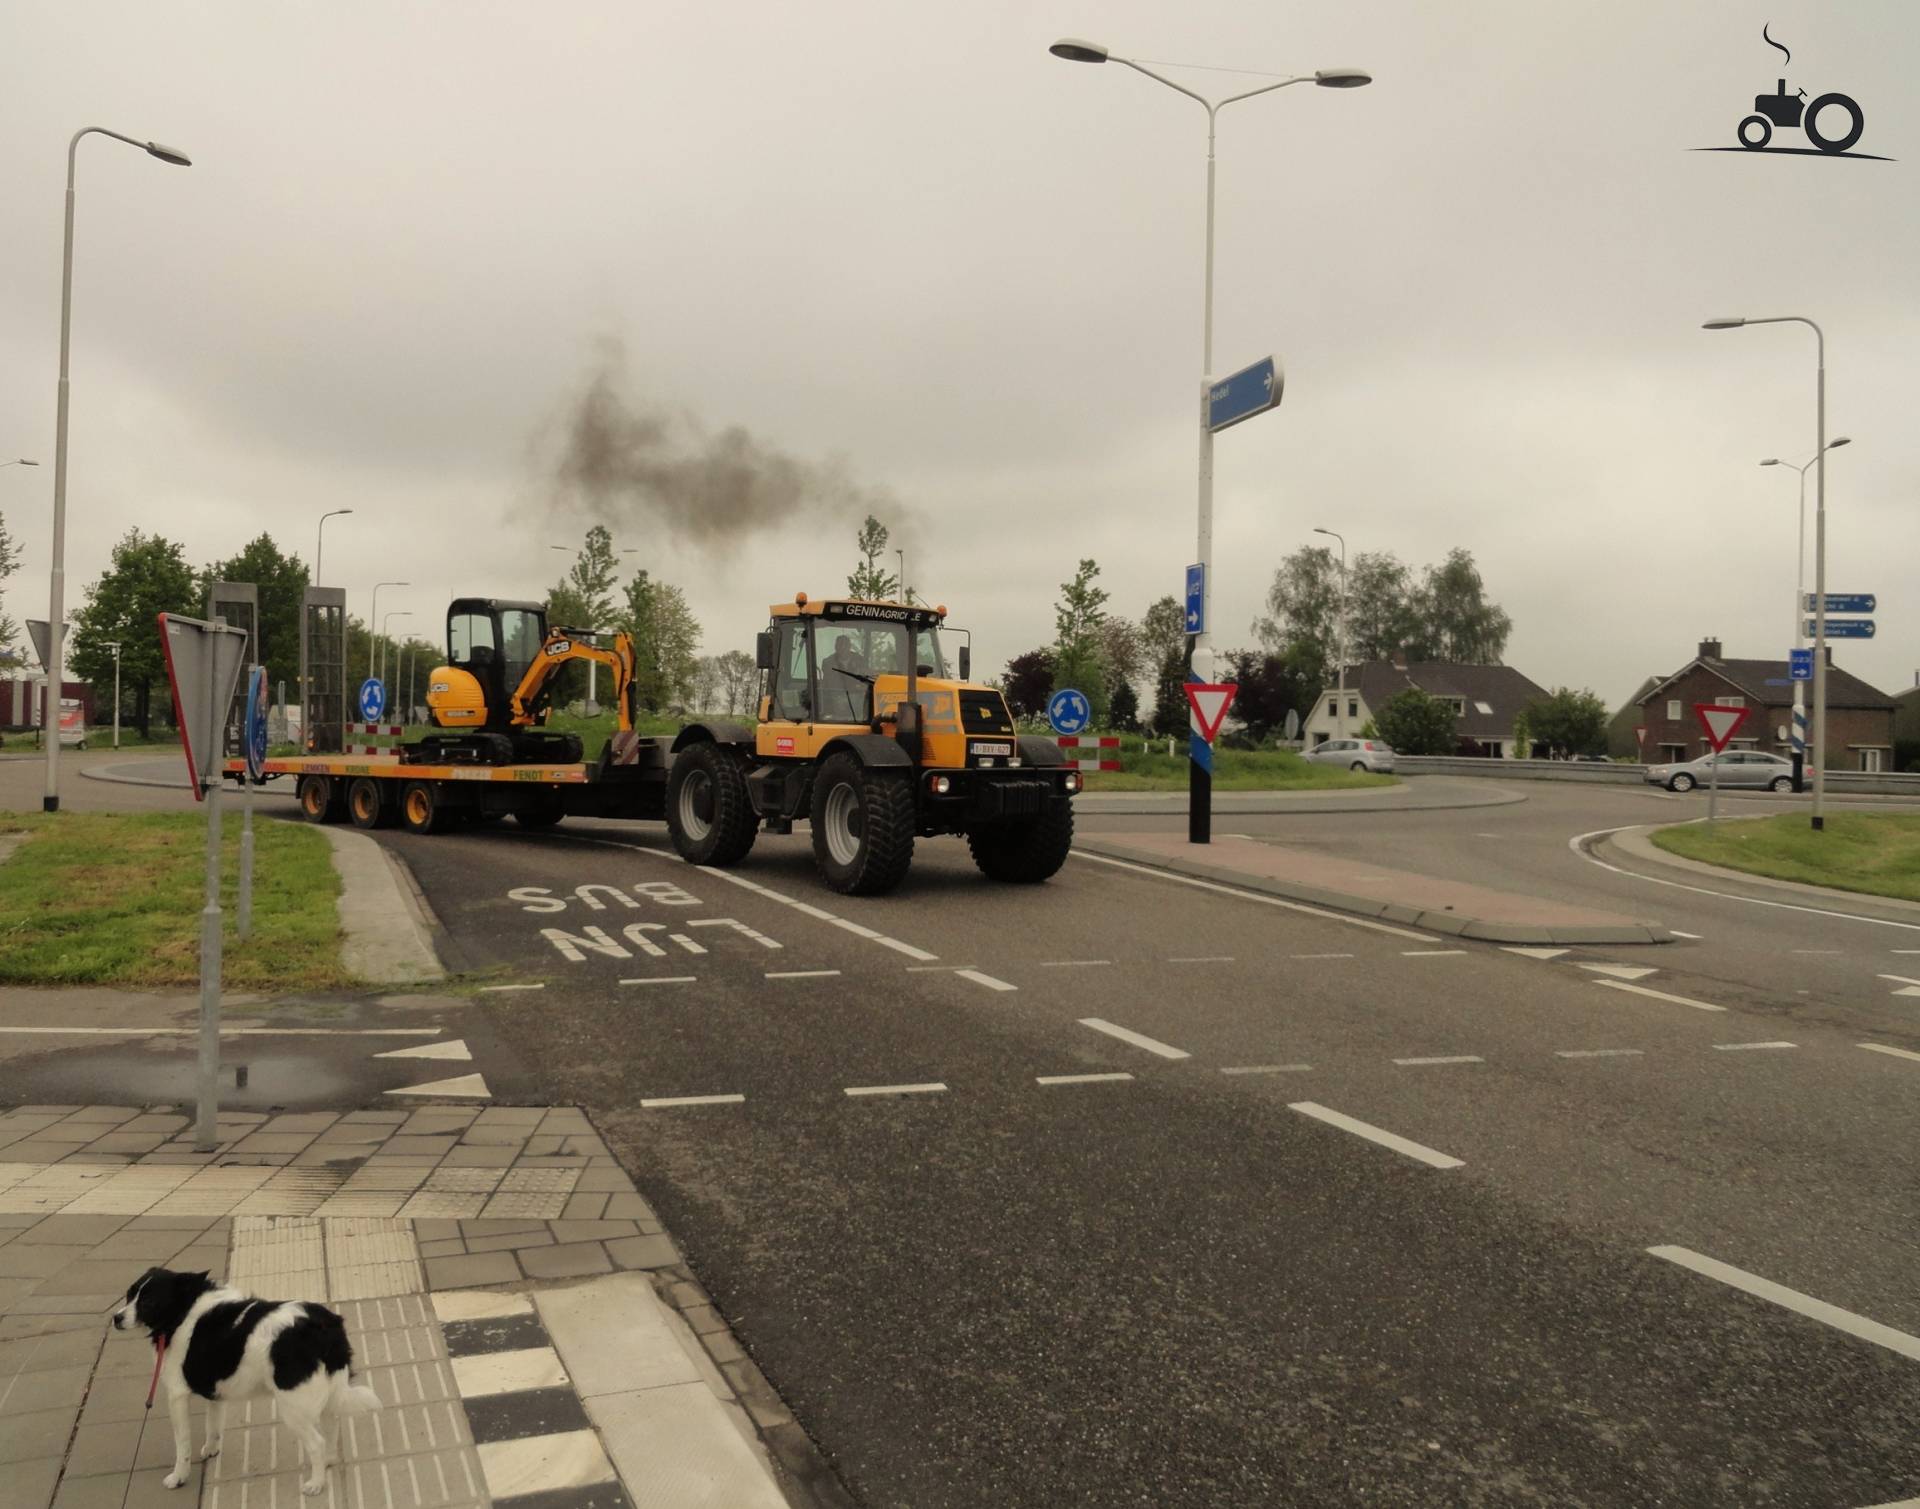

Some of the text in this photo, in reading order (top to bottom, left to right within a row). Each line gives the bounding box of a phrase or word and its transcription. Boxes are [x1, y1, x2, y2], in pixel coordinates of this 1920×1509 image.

[846, 604, 922, 621] GENIN AGRICE
[547, 641, 570, 655] JCB
[513, 769, 543, 781] FENDT
[507, 881, 705, 913] BUS
[540, 918, 784, 962] LIJN
